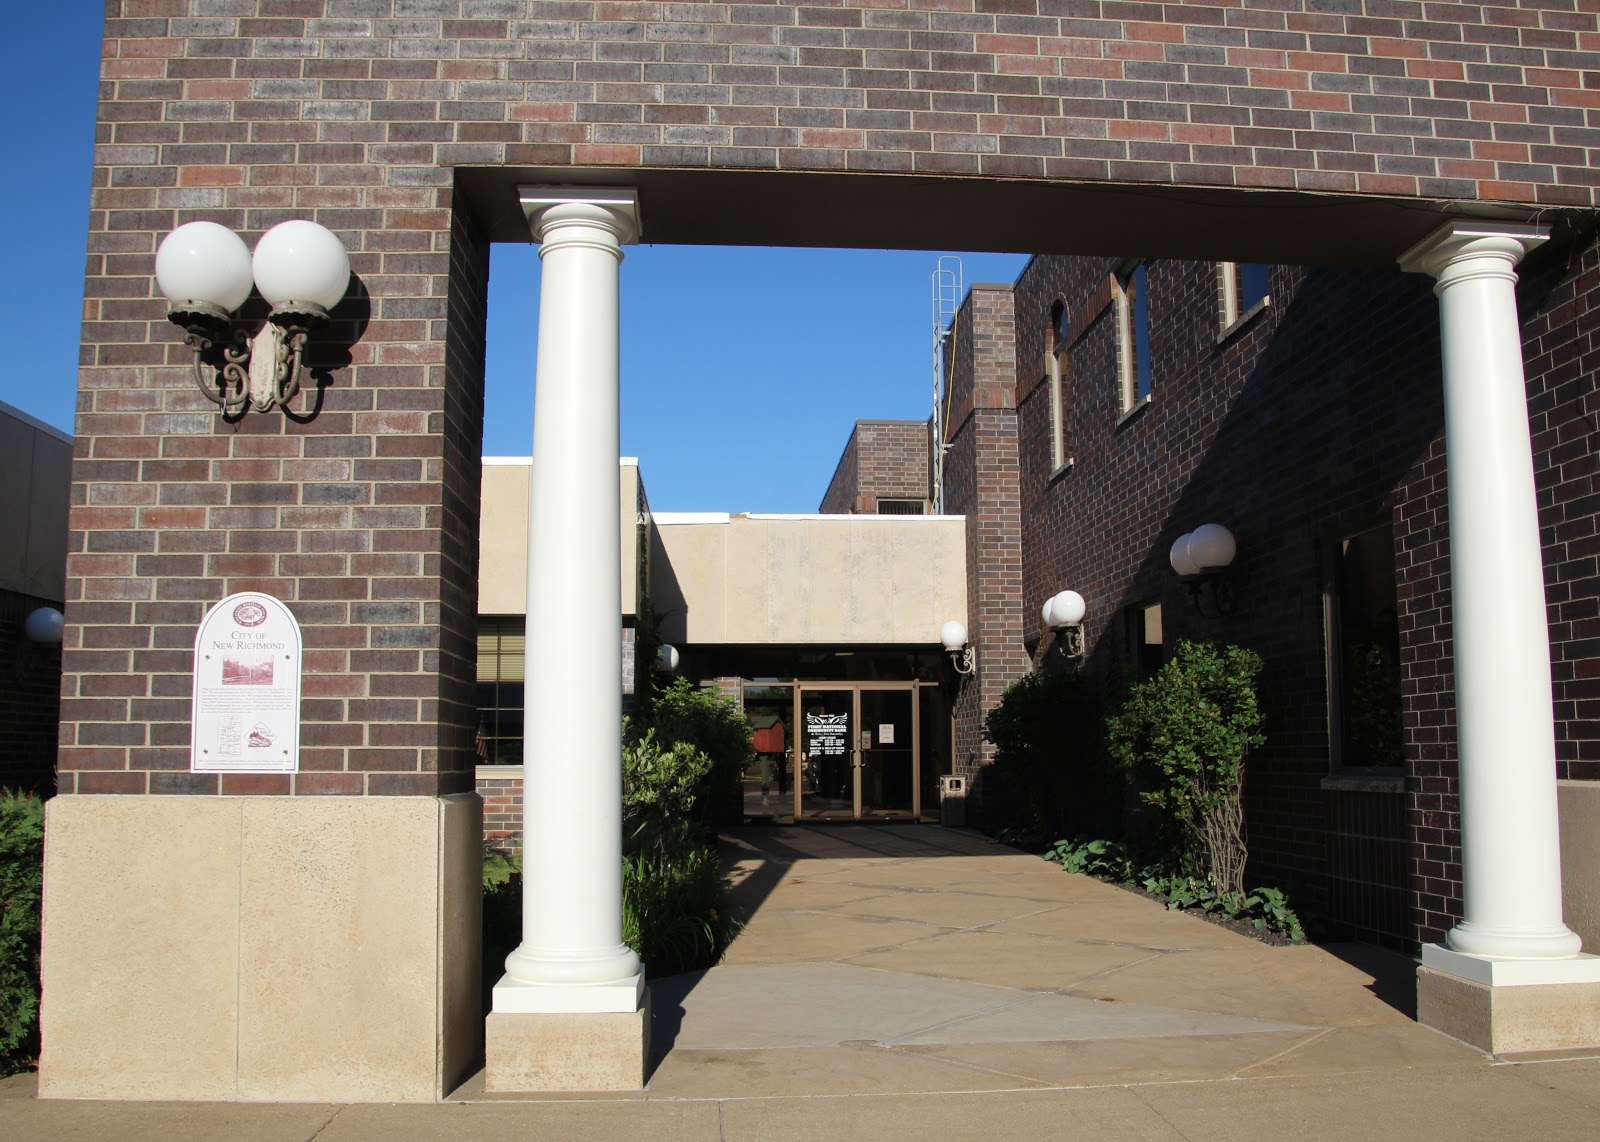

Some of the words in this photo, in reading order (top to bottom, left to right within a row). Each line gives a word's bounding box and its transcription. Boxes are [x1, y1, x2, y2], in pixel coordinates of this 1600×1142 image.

[231, 630, 253, 640] CITY
[212, 641, 234, 650] NEW
[236, 641, 285, 650] RICHMOND
